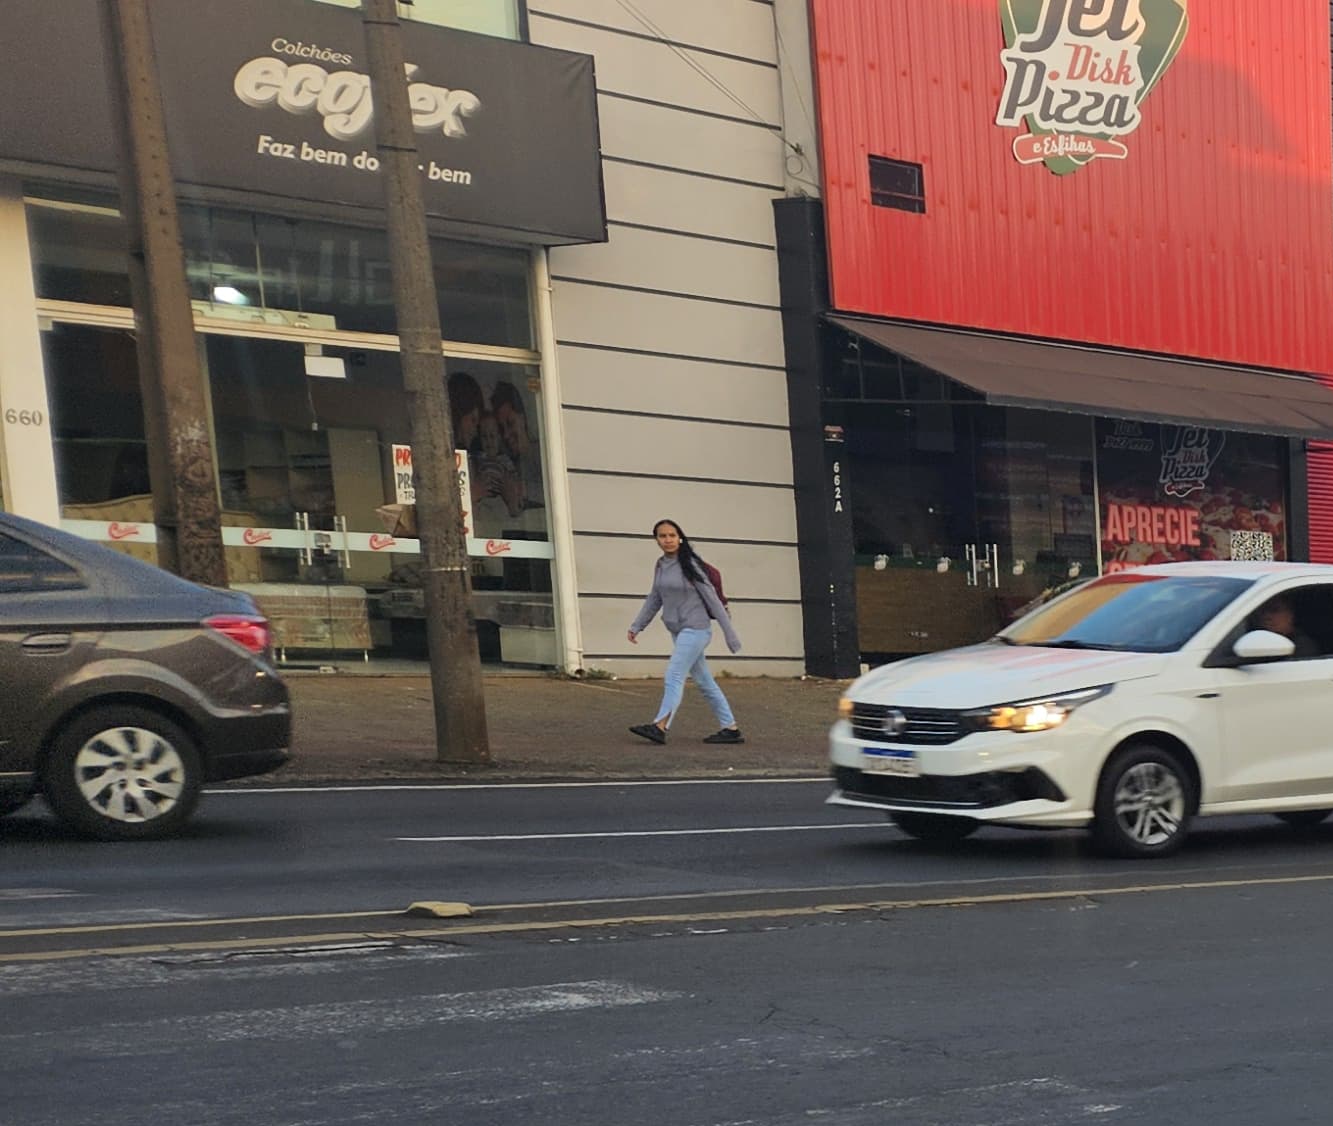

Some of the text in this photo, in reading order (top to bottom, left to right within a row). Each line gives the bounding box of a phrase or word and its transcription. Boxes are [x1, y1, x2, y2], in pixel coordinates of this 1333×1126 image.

[271, 38, 353, 66] Colchões
[1064, 42, 1136, 86] Disk
[1003, 57, 1136, 129] Pizza
[257, 134, 296, 159] Faz
[300, 142, 348, 167] bem
[428, 161, 472, 184] bem
[1033, 134, 1097, 156] e Esfihas
[5, 407, 43, 426] 660
[1106, 503, 1201, 546] APRECIE
